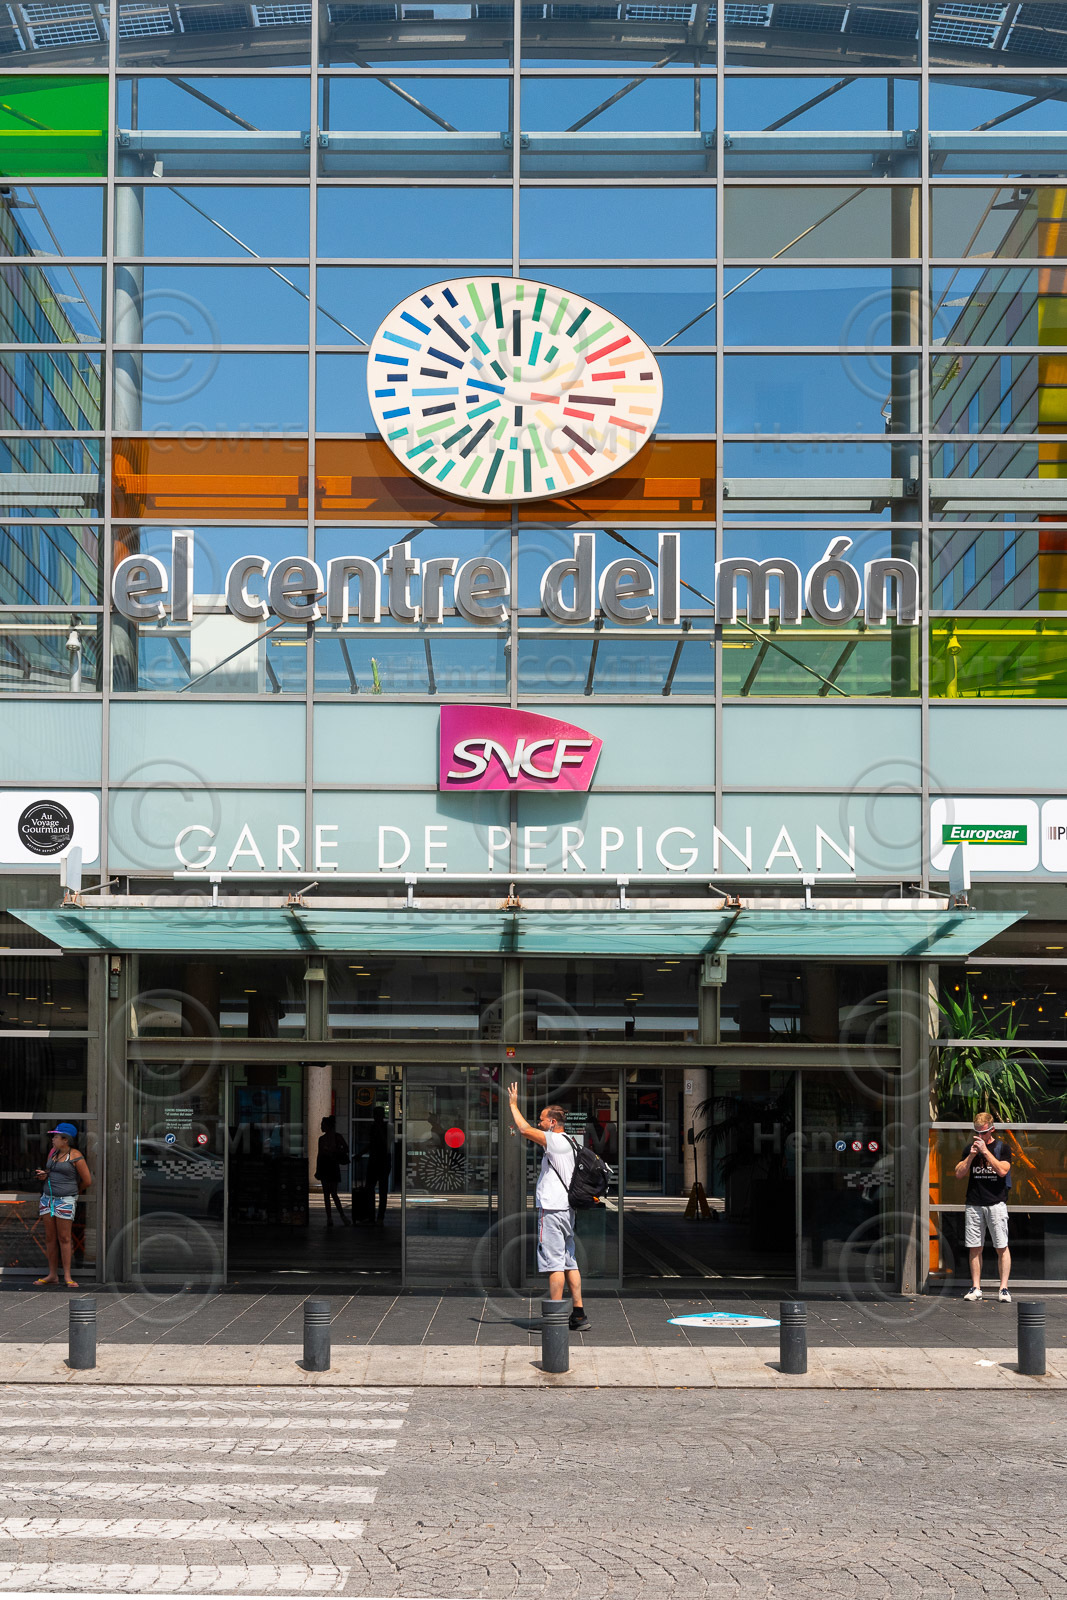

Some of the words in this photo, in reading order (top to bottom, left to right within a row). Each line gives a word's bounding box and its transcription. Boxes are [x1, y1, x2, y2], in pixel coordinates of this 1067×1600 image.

[112, 530, 195, 623] el
[225, 541, 511, 625] centre
[540, 533, 681, 625] del
[714, 536, 920, 625] món
[447, 738, 593, 779] SNCF
[31, 818, 60, 828] Voyage
[40, 812, 53, 820] Au
[21, 824, 70, 834] Gourmand
[950, 826, 1020, 842] Europcar
[174, 824, 340, 870] GARE
[378, 825, 449, 870] DE
[488, 824, 856, 871] PERPIGNAN
